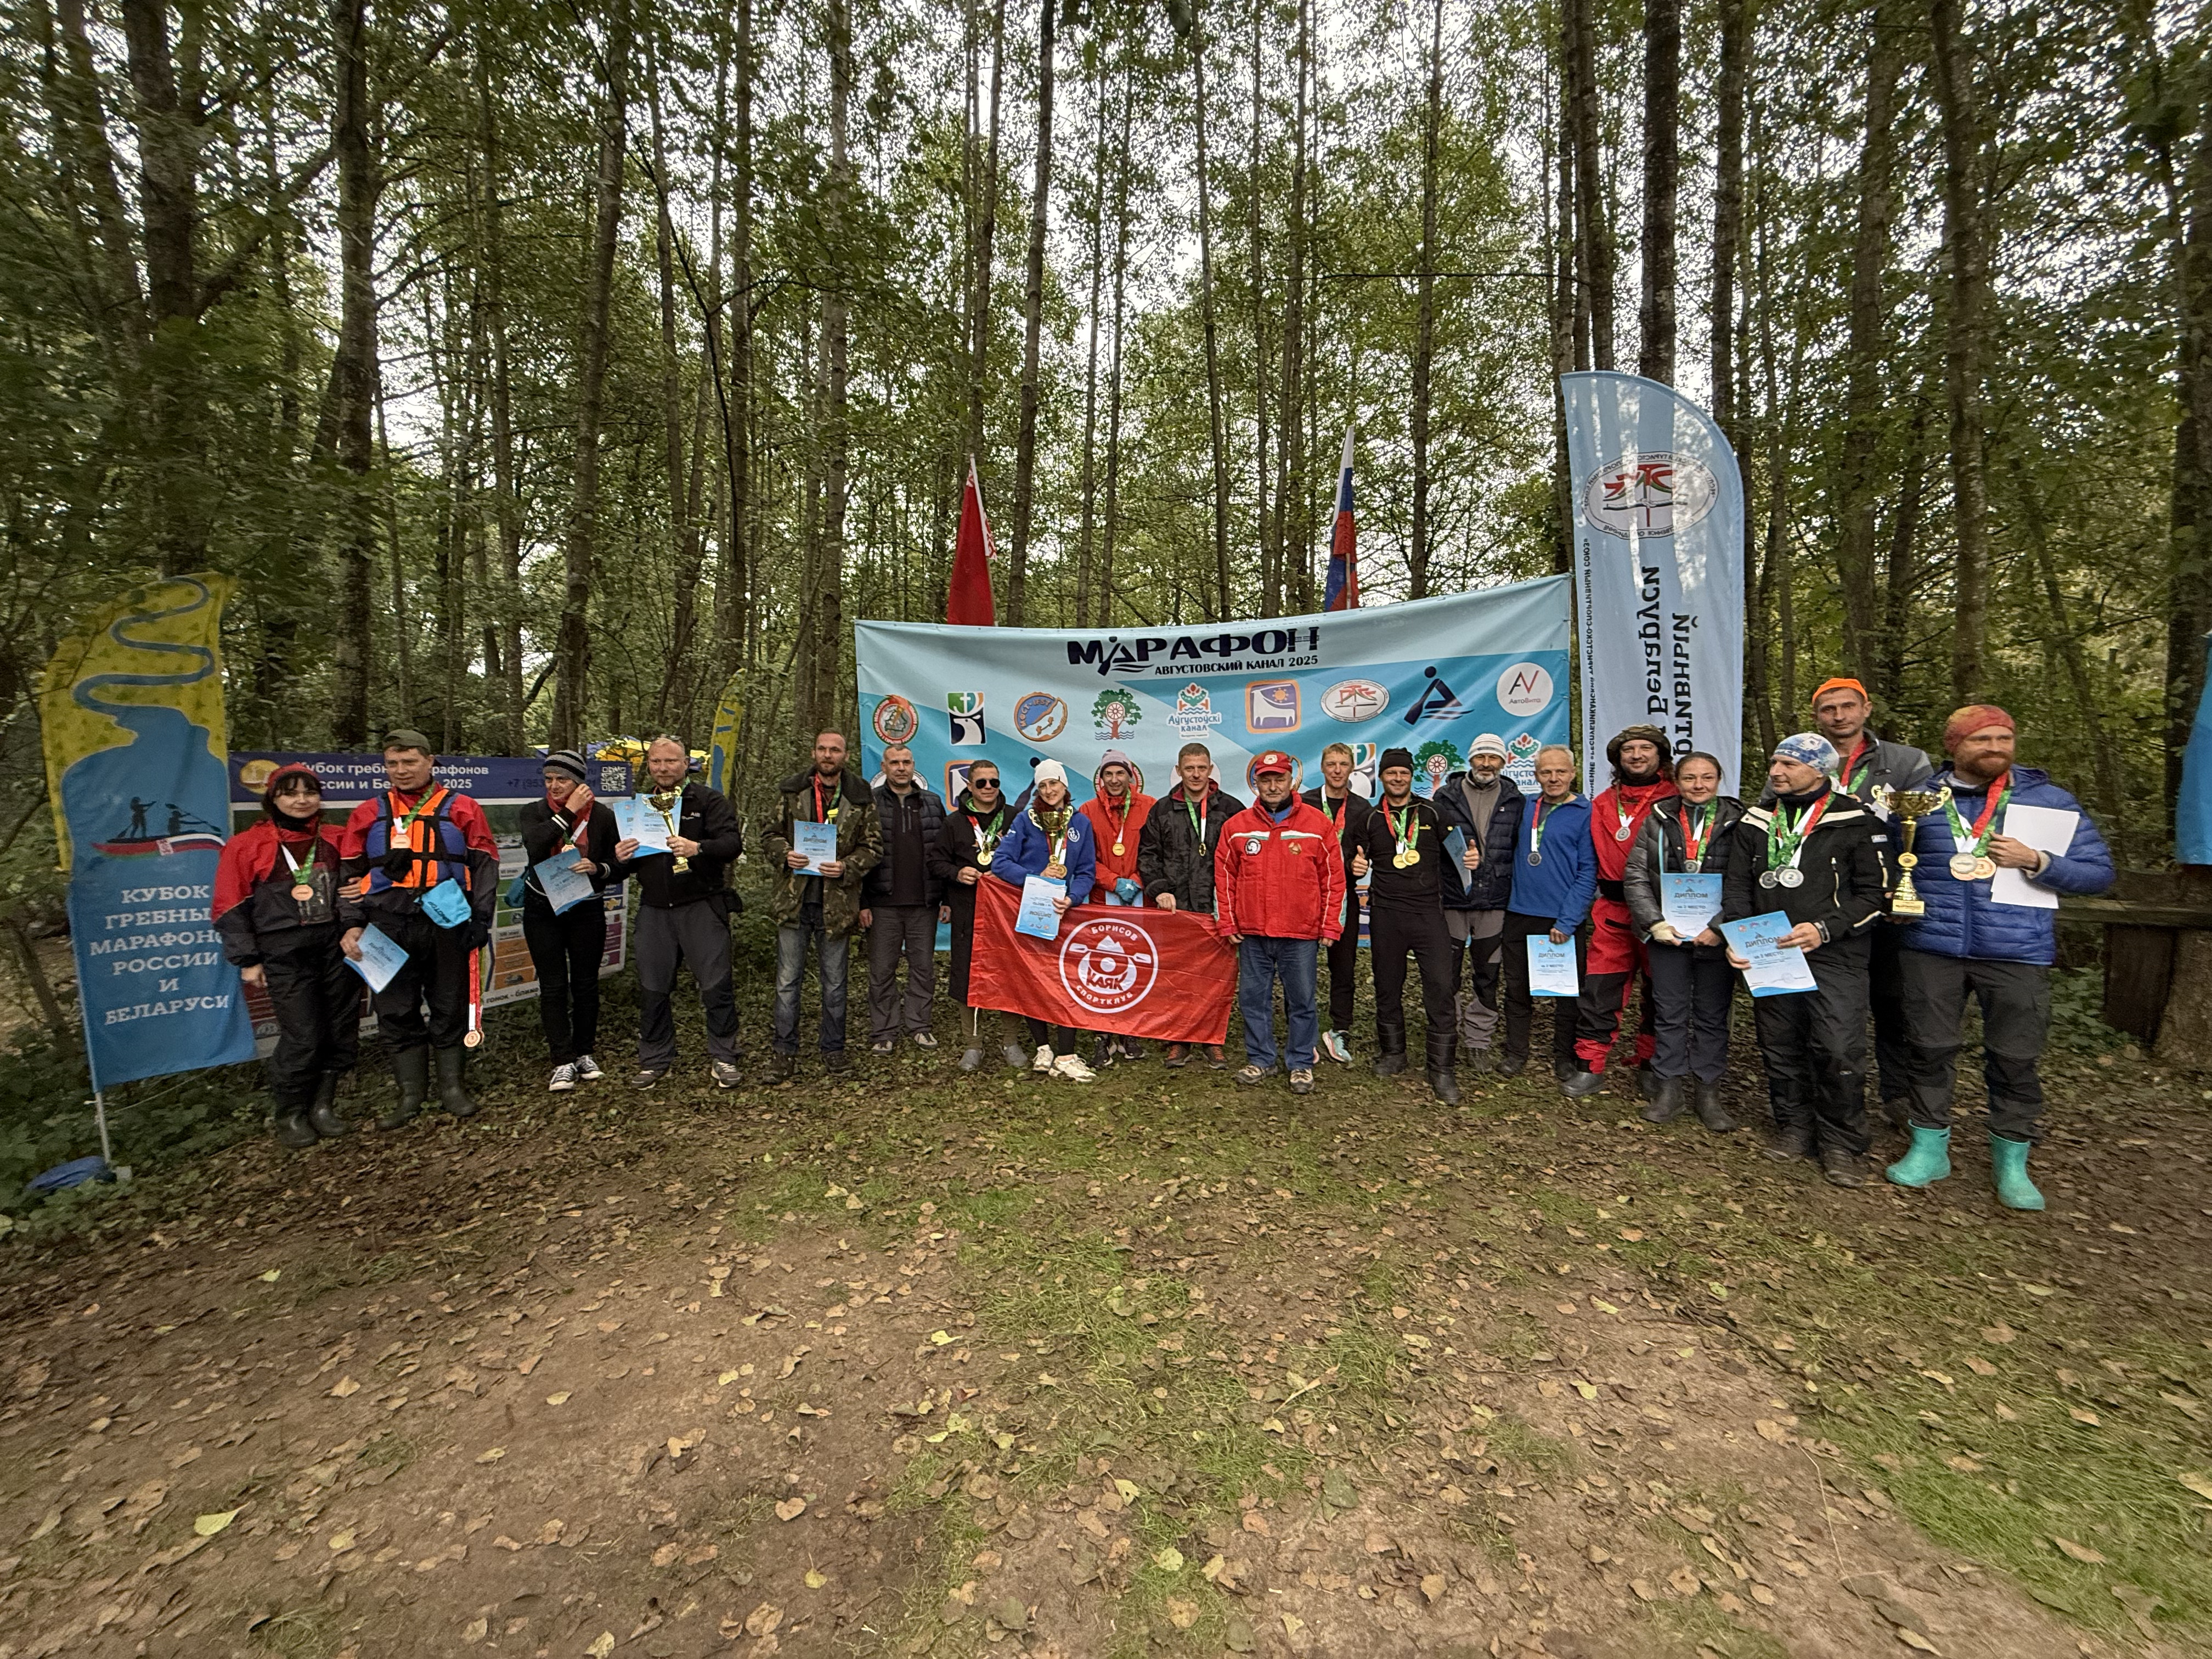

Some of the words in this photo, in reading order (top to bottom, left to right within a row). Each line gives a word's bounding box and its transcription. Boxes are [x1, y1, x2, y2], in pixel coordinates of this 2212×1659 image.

[1155, 660, 1243, 675] АВГУСТОВСКИЙ
[1246, 659, 1284, 670] КАНАЛ
[1289, 656, 1318, 667] 2025
[1168, 714, 1220, 725] Аўгустоўскі
[303, 762, 344, 774] убок
[348, 763, 387, 776] гребн
[432, 764, 489, 776] рафонов
[319, 780, 354, 789] ссии
[359, 781, 369, 789] и
[443, 778, 473, 789] 2025
[121, 885, 210, 904] КУБОК
[105, 907, 211, 930] ГРЕБНЫ
[1091, 924, 1138, 941] БОРИСОВ
[112, 952, 218, 975] РОССИИ
[159, 978, 179, 992] И
[1086, 967, 1128, 991] КАЯК
[1076, 985, 1133, 1005] СПОРТКЛУБ
[104, 995, 229, 1025] БЕЛАРУСИ
